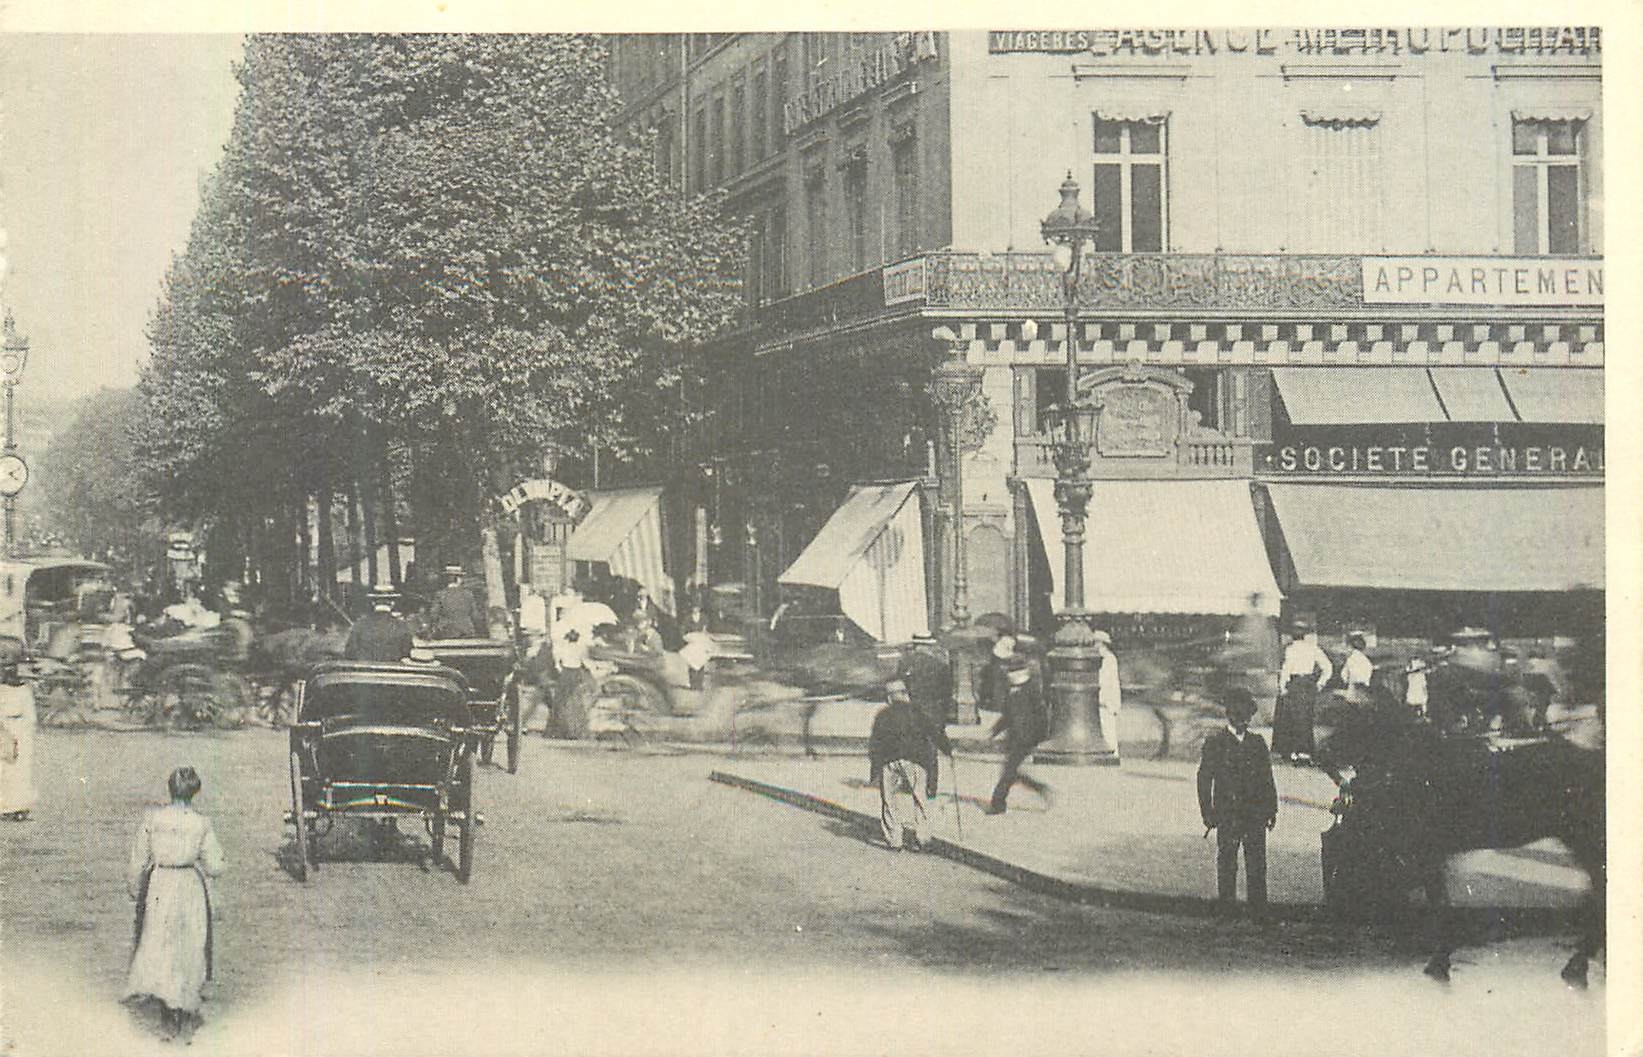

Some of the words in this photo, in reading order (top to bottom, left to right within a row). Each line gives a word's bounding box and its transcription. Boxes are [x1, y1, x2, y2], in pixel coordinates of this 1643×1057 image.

[995, 31, 1089, 50] VIAGERES
[1374, 266, 1604, 295] APPARTEMEN
[1281, 446, 1430, 471] SOCIETE
